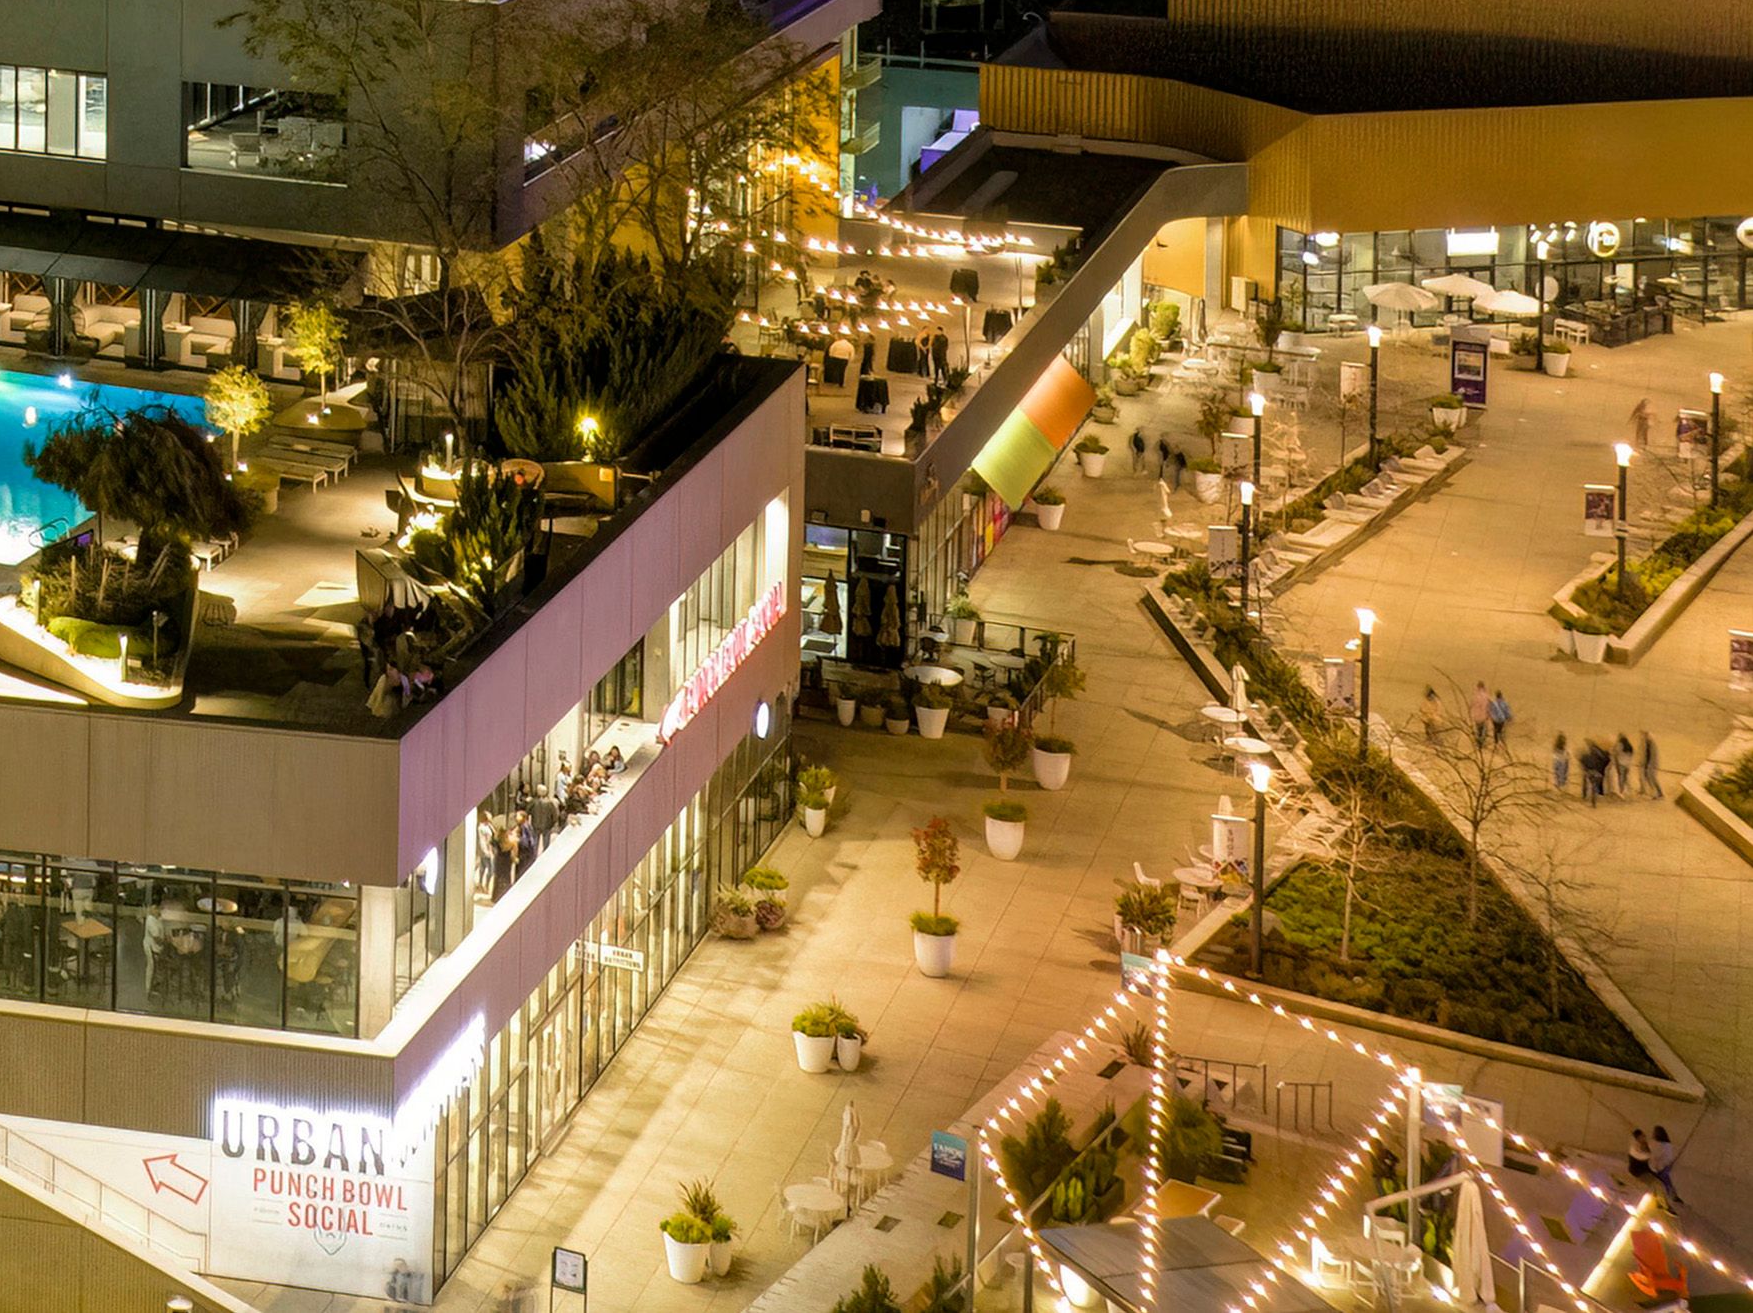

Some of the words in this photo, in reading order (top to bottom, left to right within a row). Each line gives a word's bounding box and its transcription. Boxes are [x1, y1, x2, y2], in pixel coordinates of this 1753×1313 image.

[221, 1109, 385, 1177] URBAN
[253, 1167, 334, 1202] PUNCH
[343, 1180, 408, 1212] BOWL
[287, 1201, 374, 1236] SOCIAL
